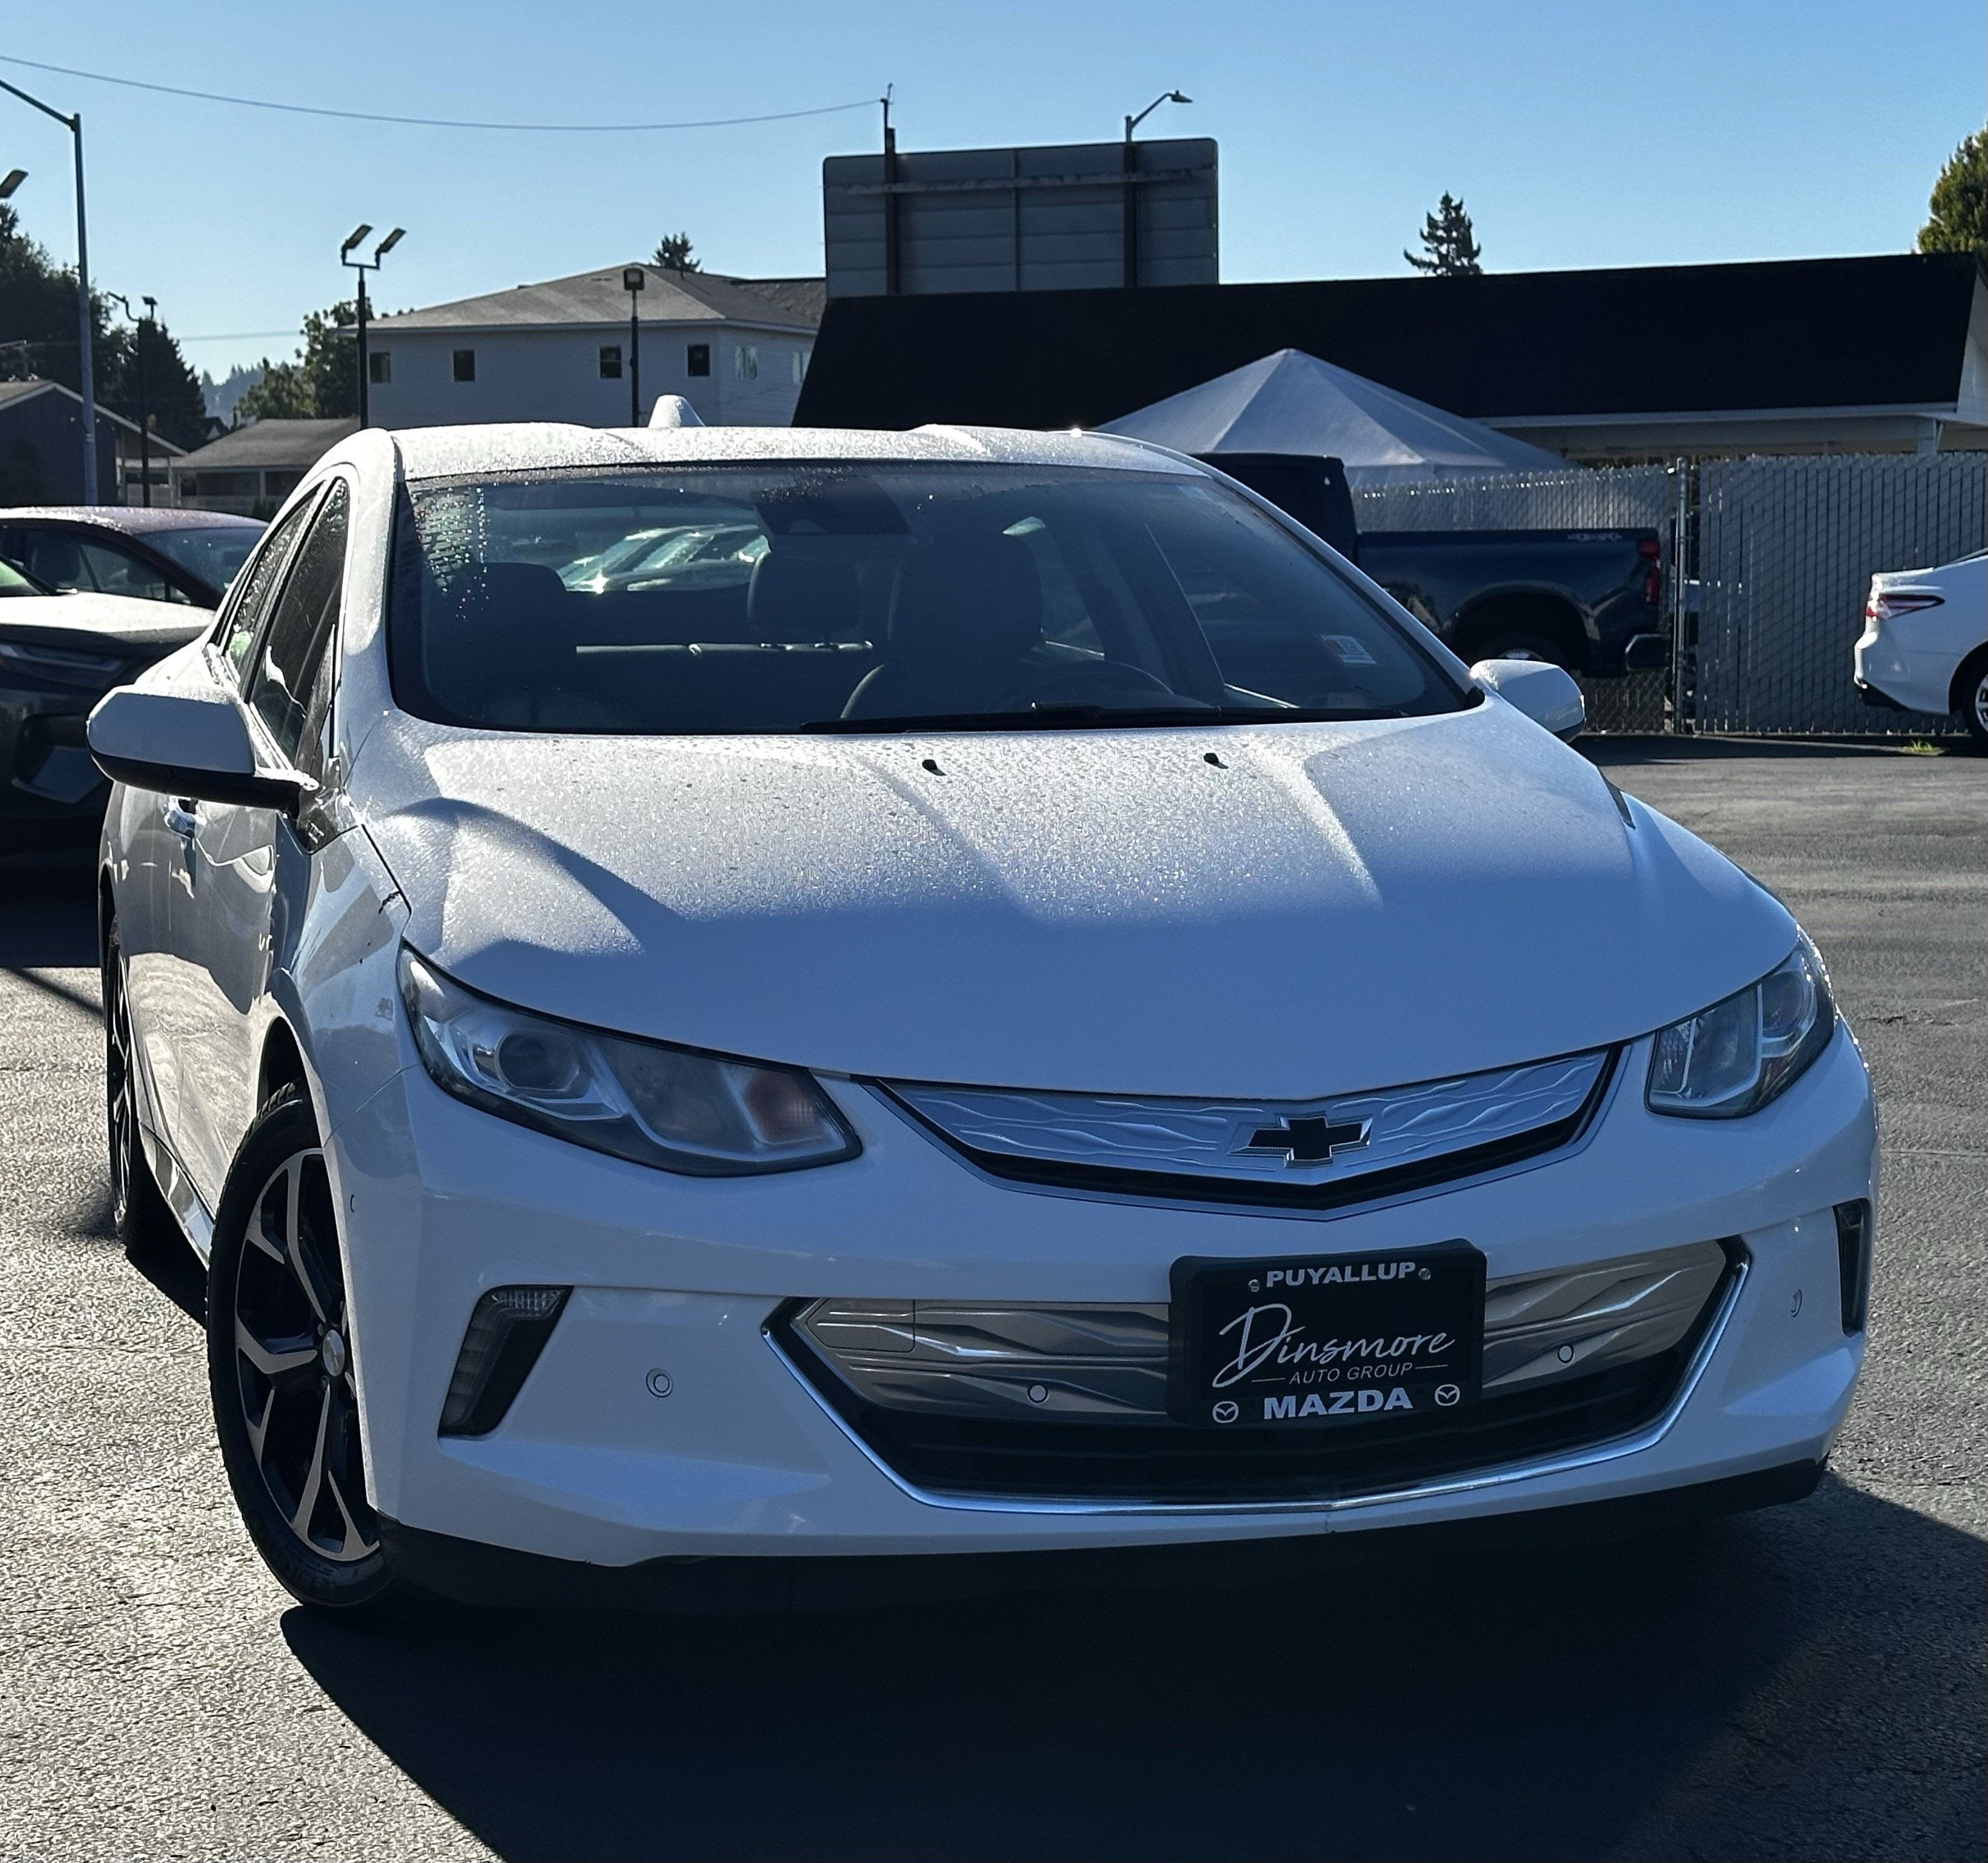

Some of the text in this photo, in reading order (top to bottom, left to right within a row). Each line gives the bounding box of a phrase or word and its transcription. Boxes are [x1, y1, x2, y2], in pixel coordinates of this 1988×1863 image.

[1266, 1262, 1416, 1288] PUYALLUP
[1212, 1303, 1455, 1388] Dinsmore
[1289, 1362, 1413, 1385] AUTO GROUP
[1264, 1387, 1413, 1419] MAZDA
